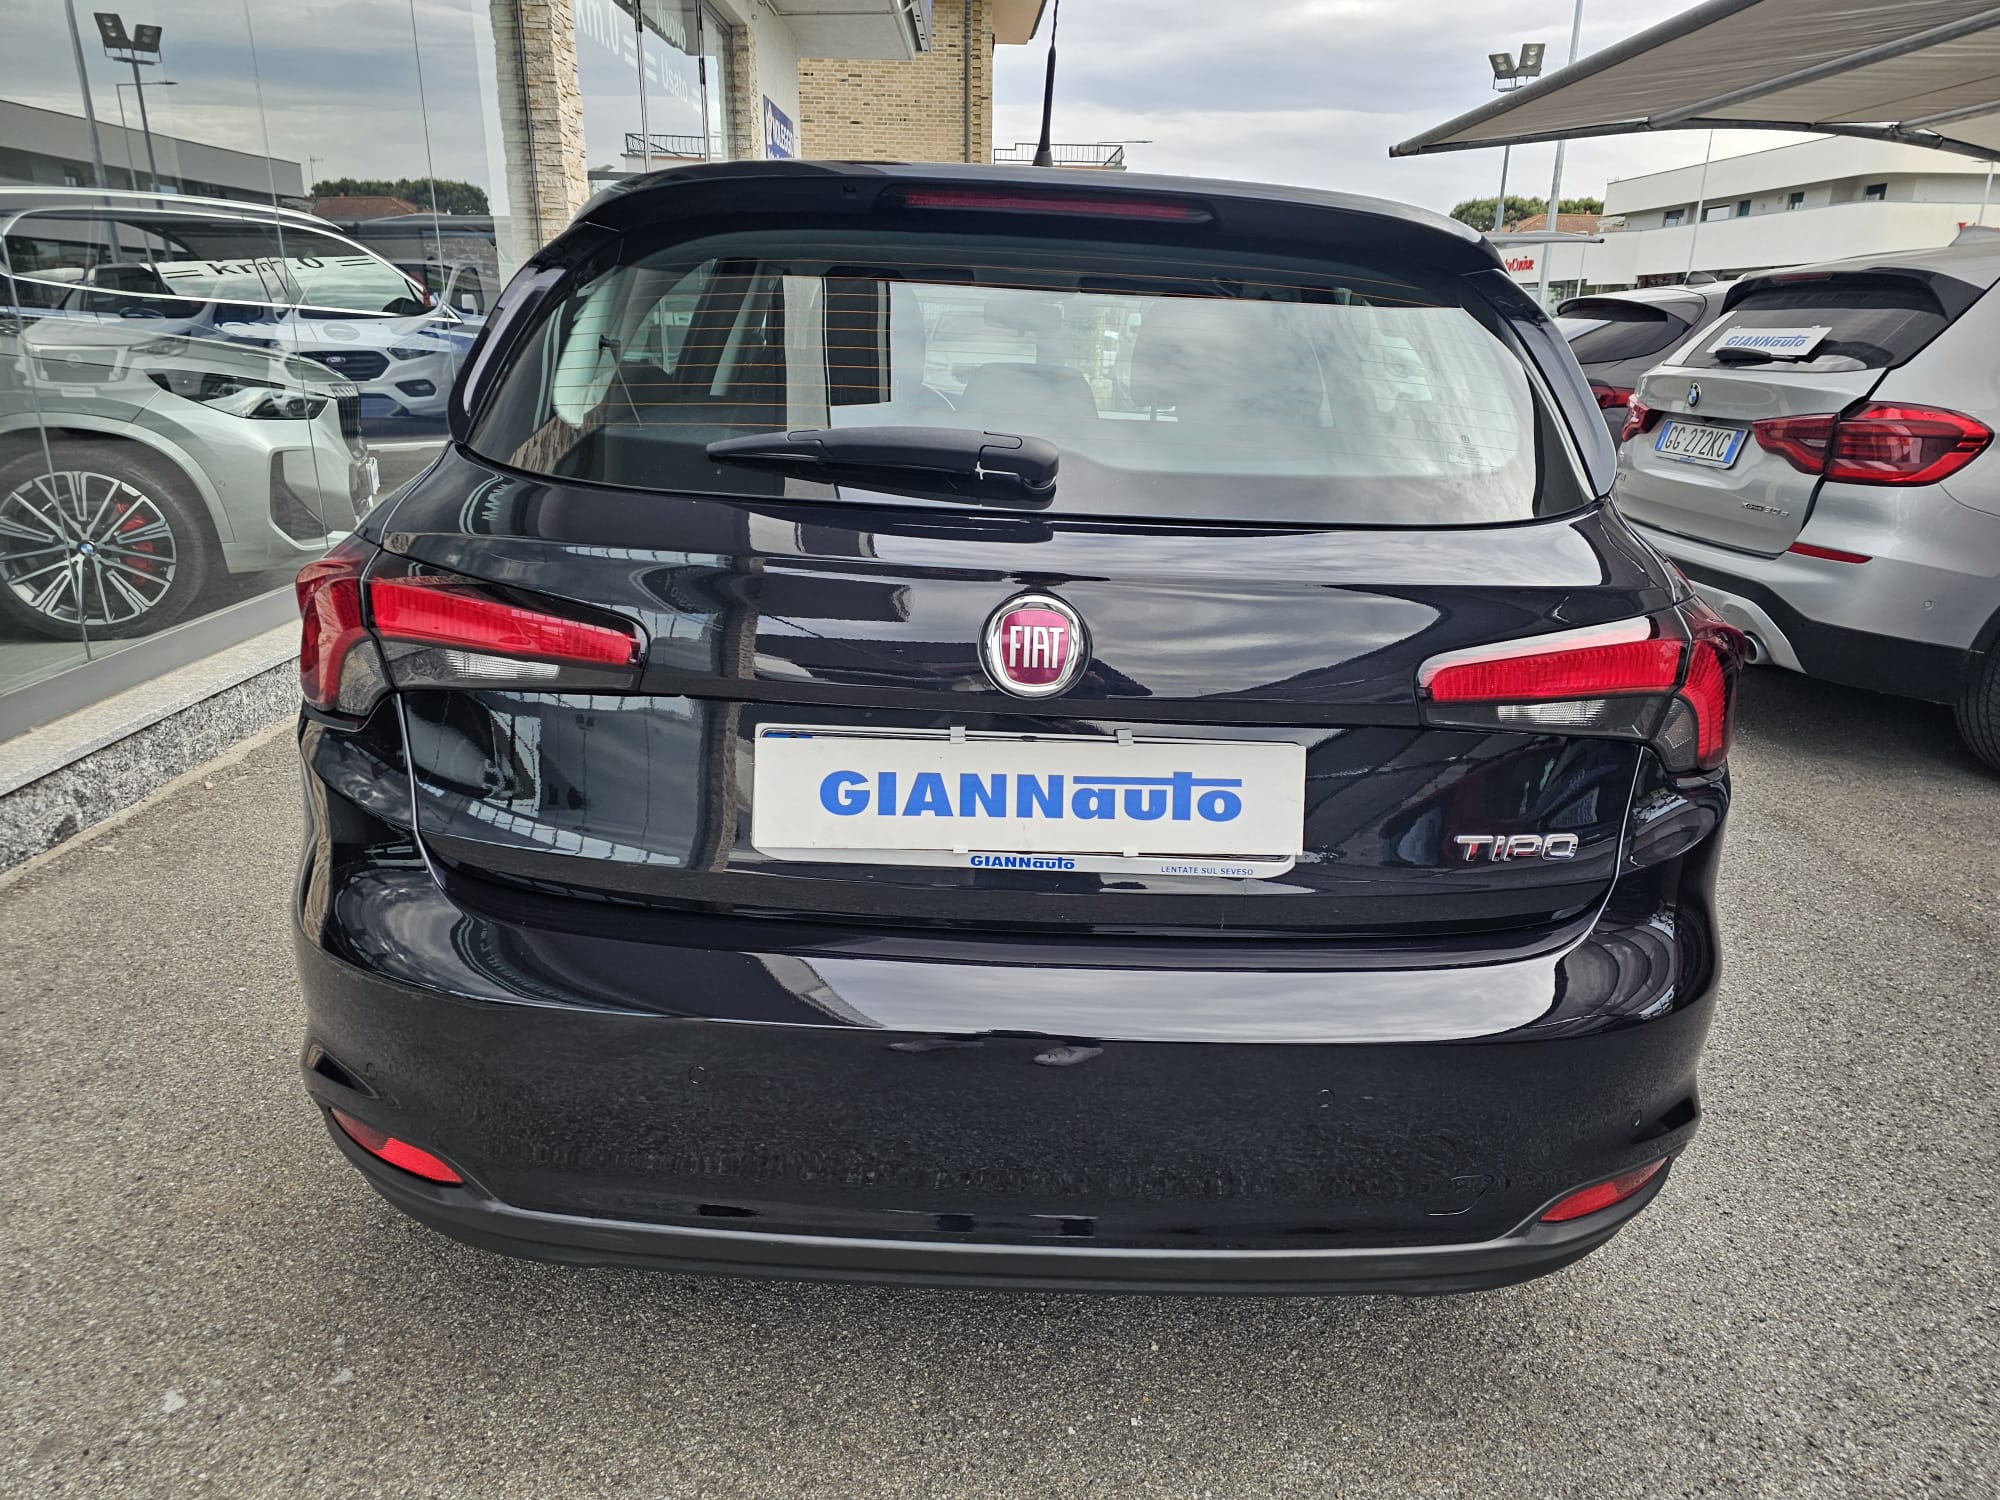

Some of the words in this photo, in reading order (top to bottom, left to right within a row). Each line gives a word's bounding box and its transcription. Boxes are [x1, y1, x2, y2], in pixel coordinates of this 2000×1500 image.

[1724, 334, 1811, 348] GIANNauto
[1665, 425, 1686, 450] GG
[1683, 428, 1732, 458] 272KC
[1009, 625, 1065, 669] FIAT
[819, 769, 1243, 822] GIANNauto
[1454, 832, 1579, 862] TIPO
[970, 855, 1076, 870] GIANNauto
[1160, 865, 1199, 874] LENTATE
[1201, 866, 1218, 875] SUL
[1220, 867, 1254, 876] SEVESO
